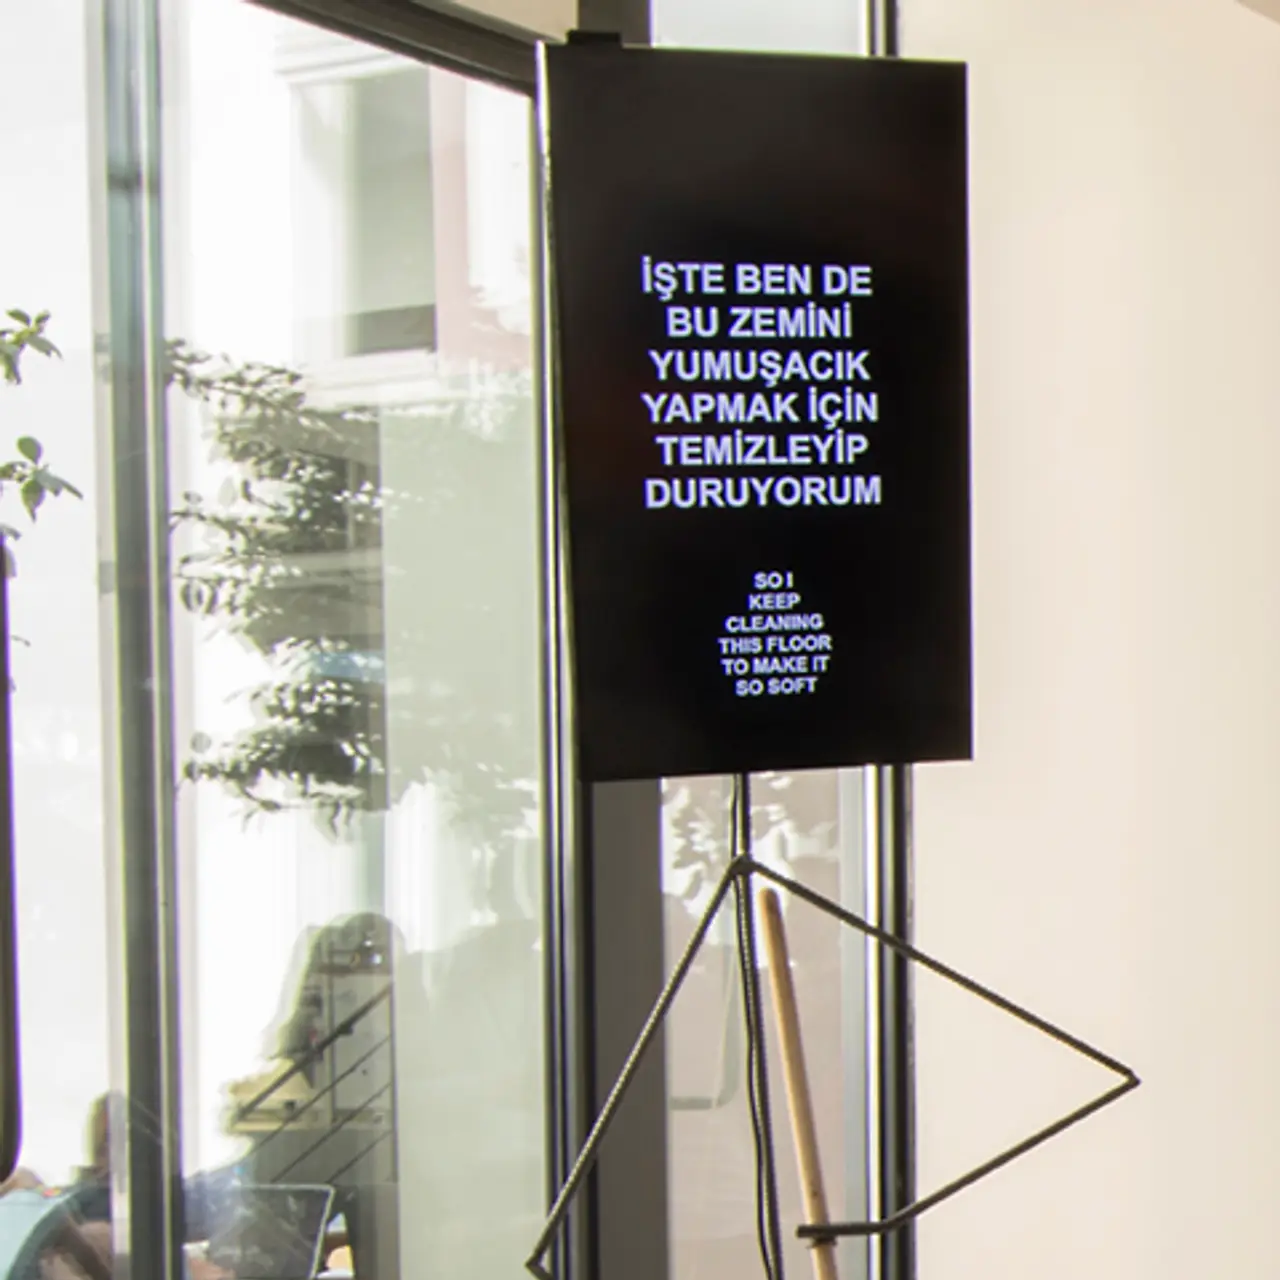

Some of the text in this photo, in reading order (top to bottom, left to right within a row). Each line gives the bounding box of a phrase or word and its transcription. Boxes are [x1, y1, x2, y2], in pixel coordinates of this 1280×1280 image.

[641, 255, 872, 302] İŞTE BEN DE
[666, 301, 852, 338] BU ZEMİNİ
[647, 349, 871, 388] YUMUŞACIK
[640, 386, 879, 430] YAPMAK İÇİN
[653, 428, 869, 465] TEMİZLEYİP
[643, 475, 882, 508] DURUYORUM
[752, 571, 794, 590] SO I
[747, 592, 801, 611] KEEP
[724, 612, 824, 633] CLEANING
[717, 633, 832, 655] THIS FLOOR
[720, 654, 830, 675] TO MAKE IT
[735, 676, 818, 697] SO SOFT
